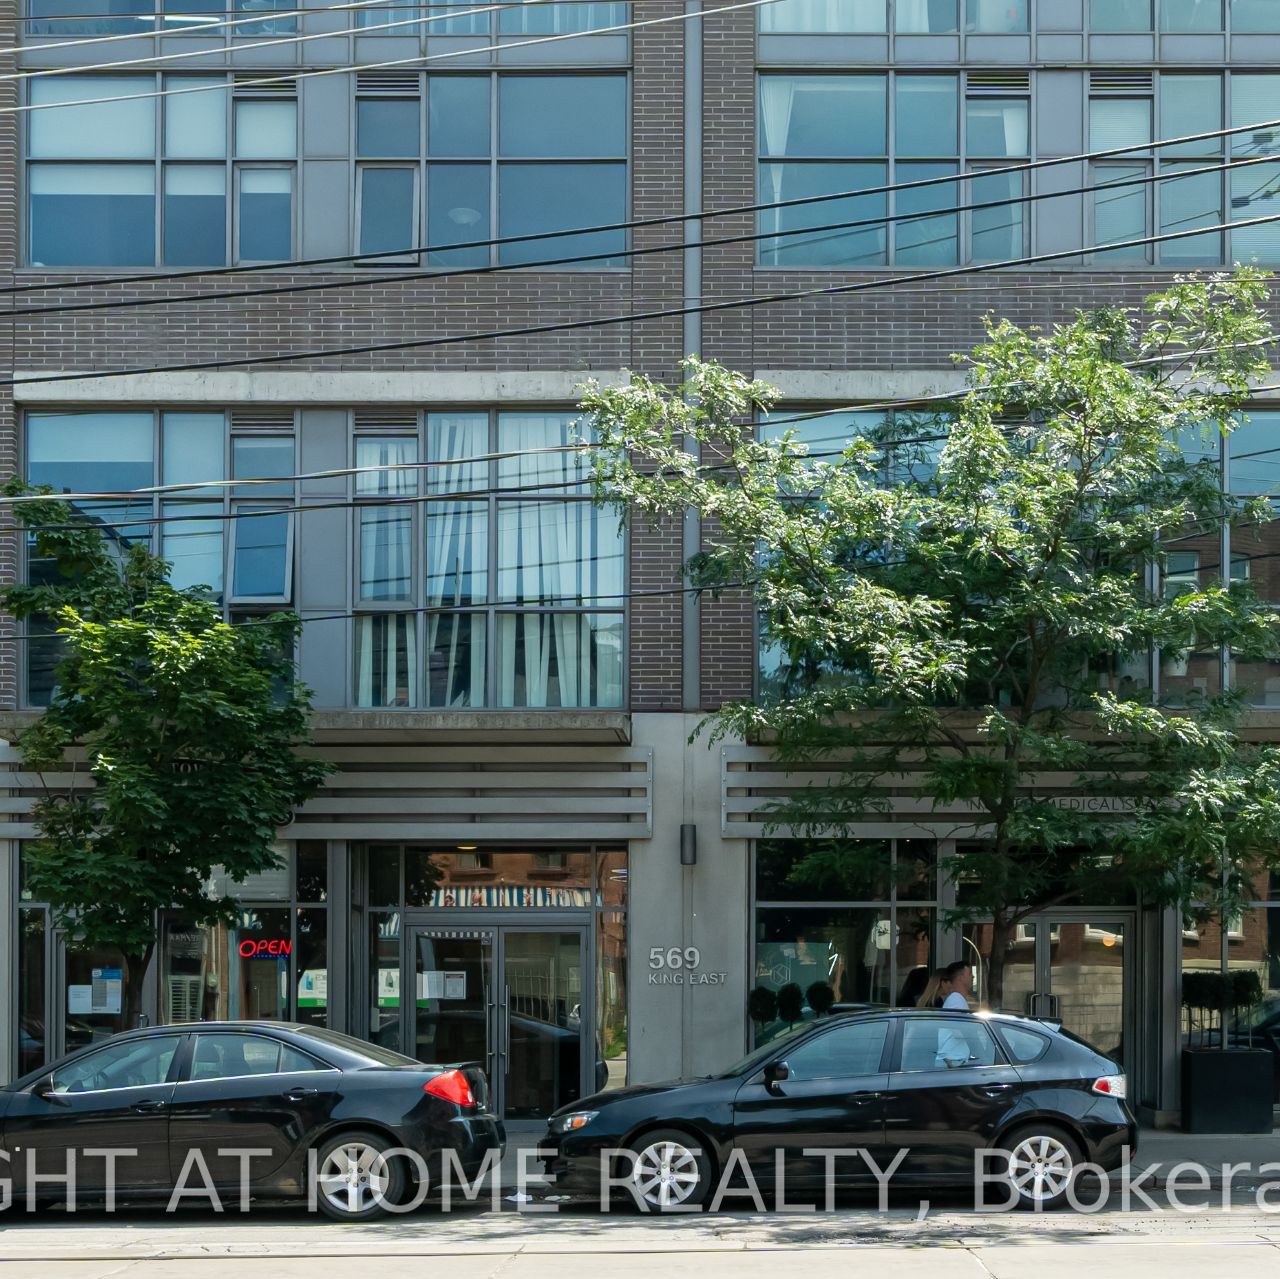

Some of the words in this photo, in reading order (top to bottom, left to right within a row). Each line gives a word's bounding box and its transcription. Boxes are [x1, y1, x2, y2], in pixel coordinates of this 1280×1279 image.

[239, 939, 292, 957] OPEN
[648, 946, 701, 970] 569
[648, 972, 684, 985] KING
[689, 972, 728, 985] EAST
